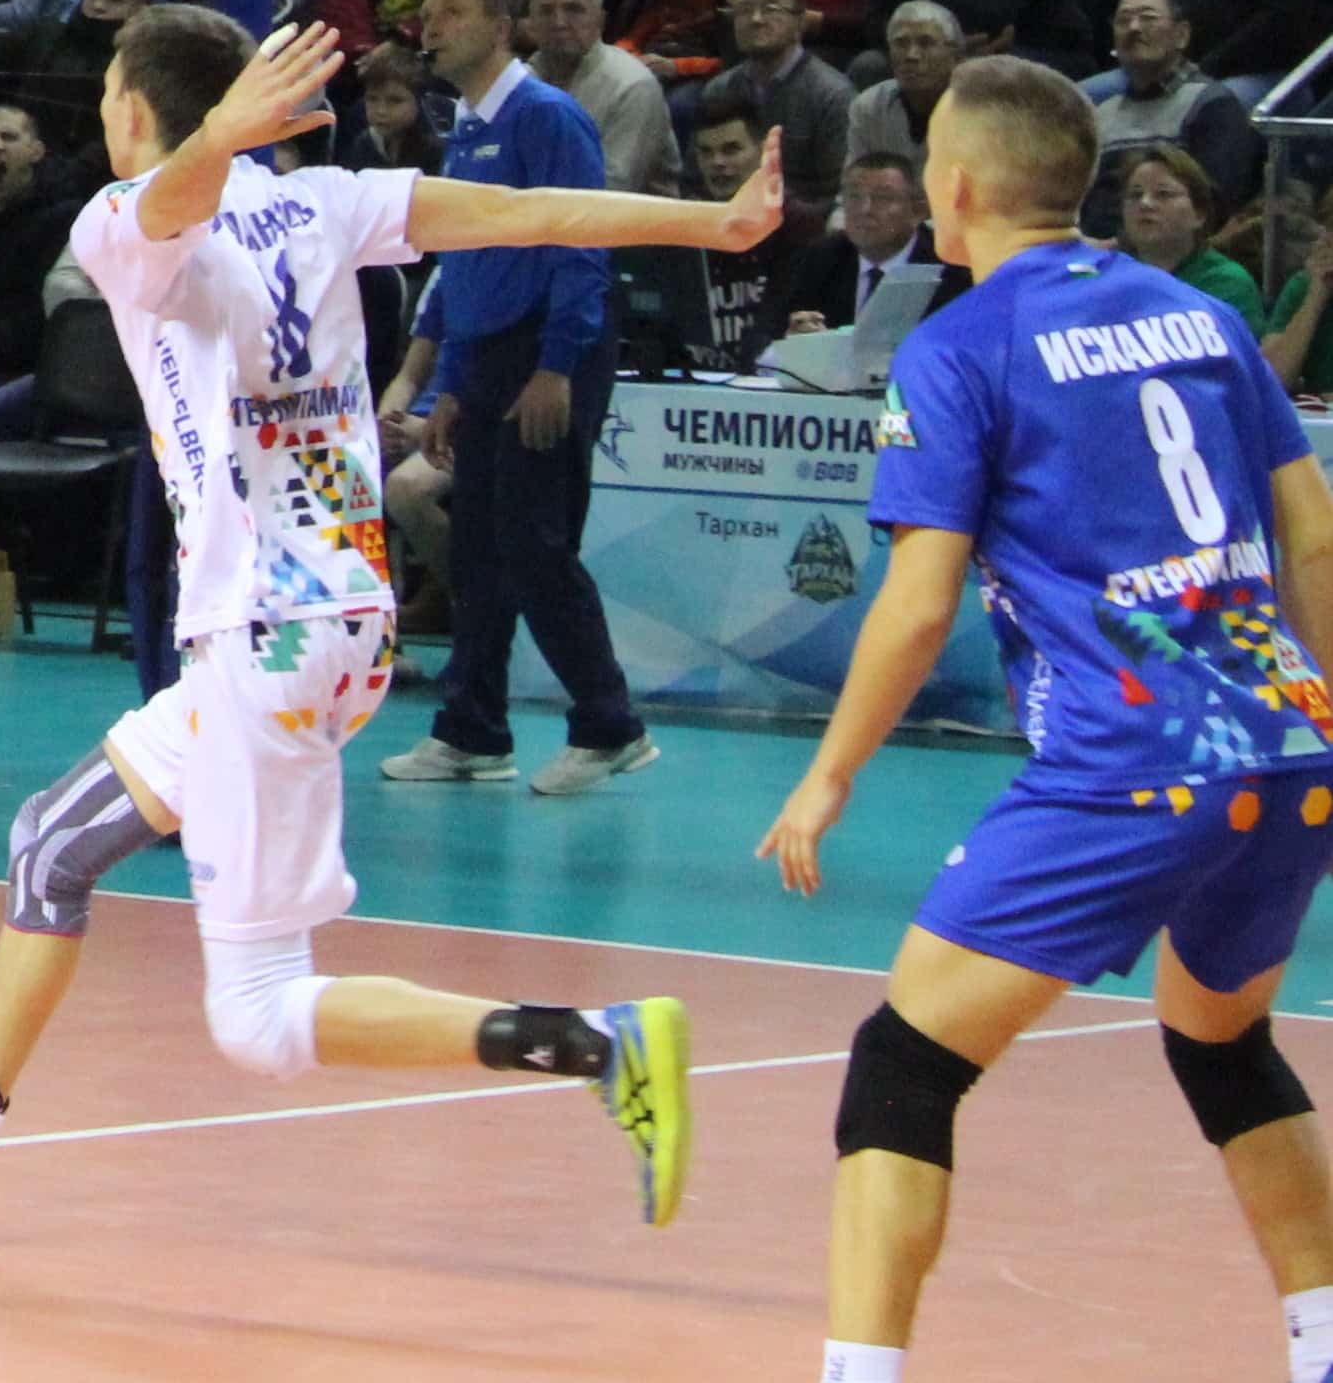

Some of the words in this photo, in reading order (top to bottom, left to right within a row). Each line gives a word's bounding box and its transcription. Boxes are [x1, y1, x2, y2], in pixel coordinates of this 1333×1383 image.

[1035, 310, 1229, 384] ИСХАКОВ
[663, 408, 880, 456] ЧЕМПИОНА
[663, 452, 765, 476] МУЖЧИНЫ
[815, 462, 858, 483] ВФВ
[1139, 377, 1227, 545] 8
[695, 512, 779, 542] Тархан
